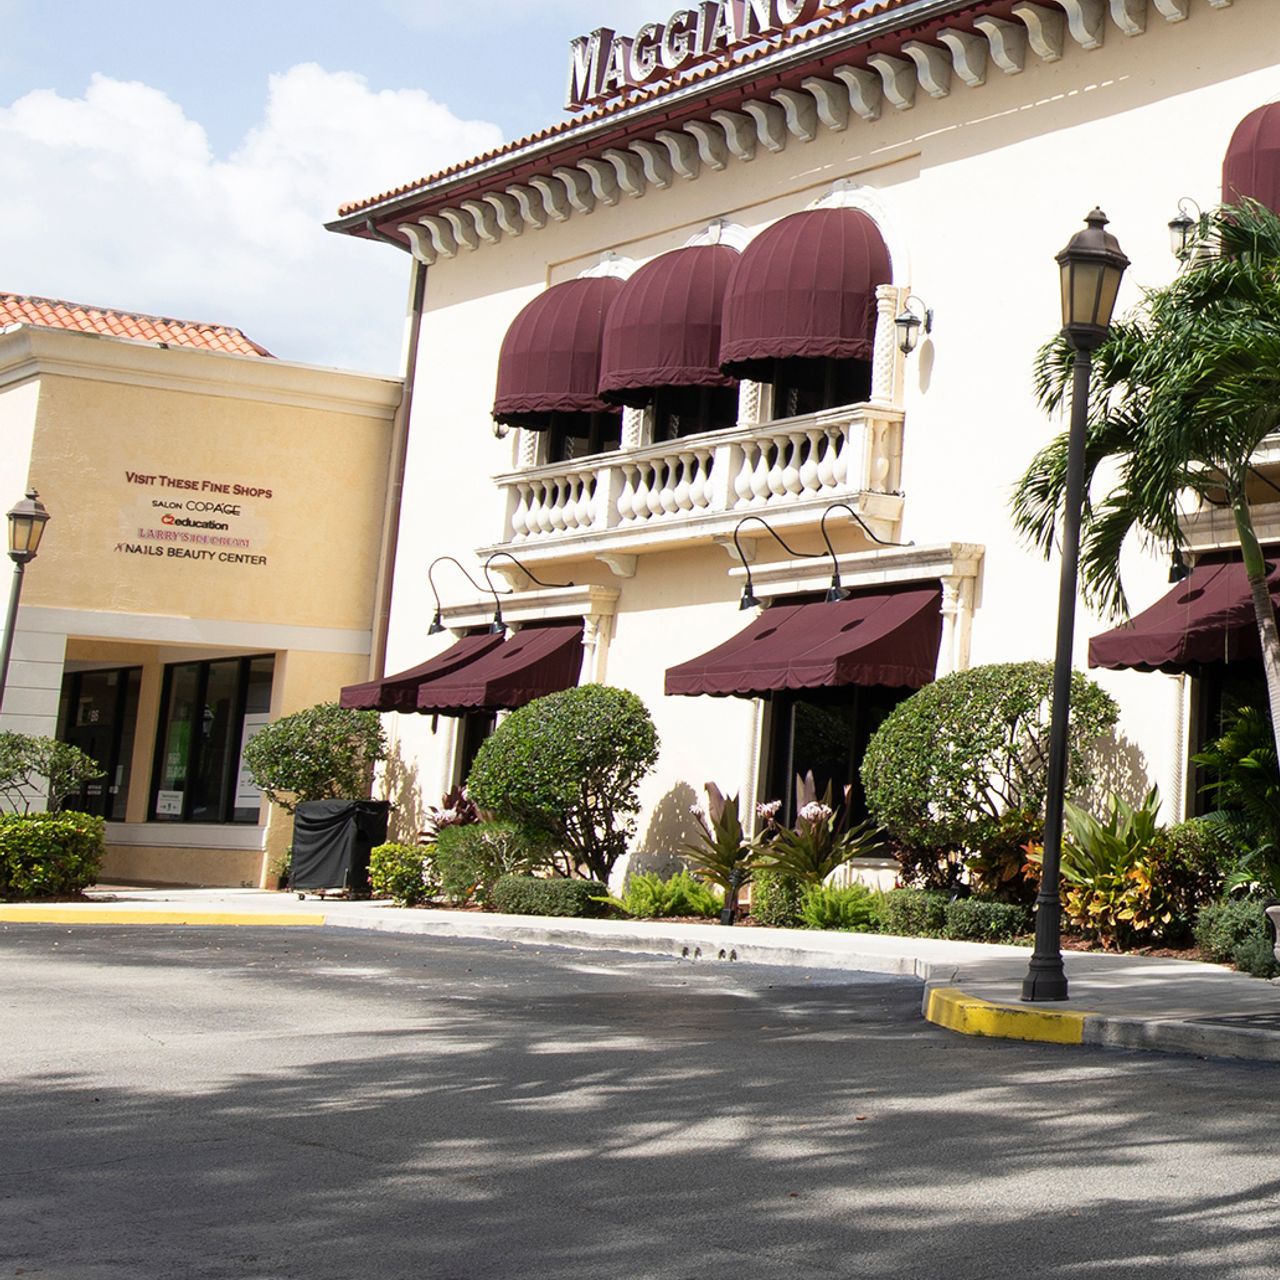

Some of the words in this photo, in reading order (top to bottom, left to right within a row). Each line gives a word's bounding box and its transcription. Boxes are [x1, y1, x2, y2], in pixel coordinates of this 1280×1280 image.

[125, 471, 157, 485] VISIT
[158, 475, 200, 491] THESE
[201, 480, 231, 494] FINE
[232, 484, 273, 499] SHOPS
[151, 500, 183, 510] SALON
[167, 547, 216, 561] BEAUTY
[218, 552, 267, 566] CENTER
